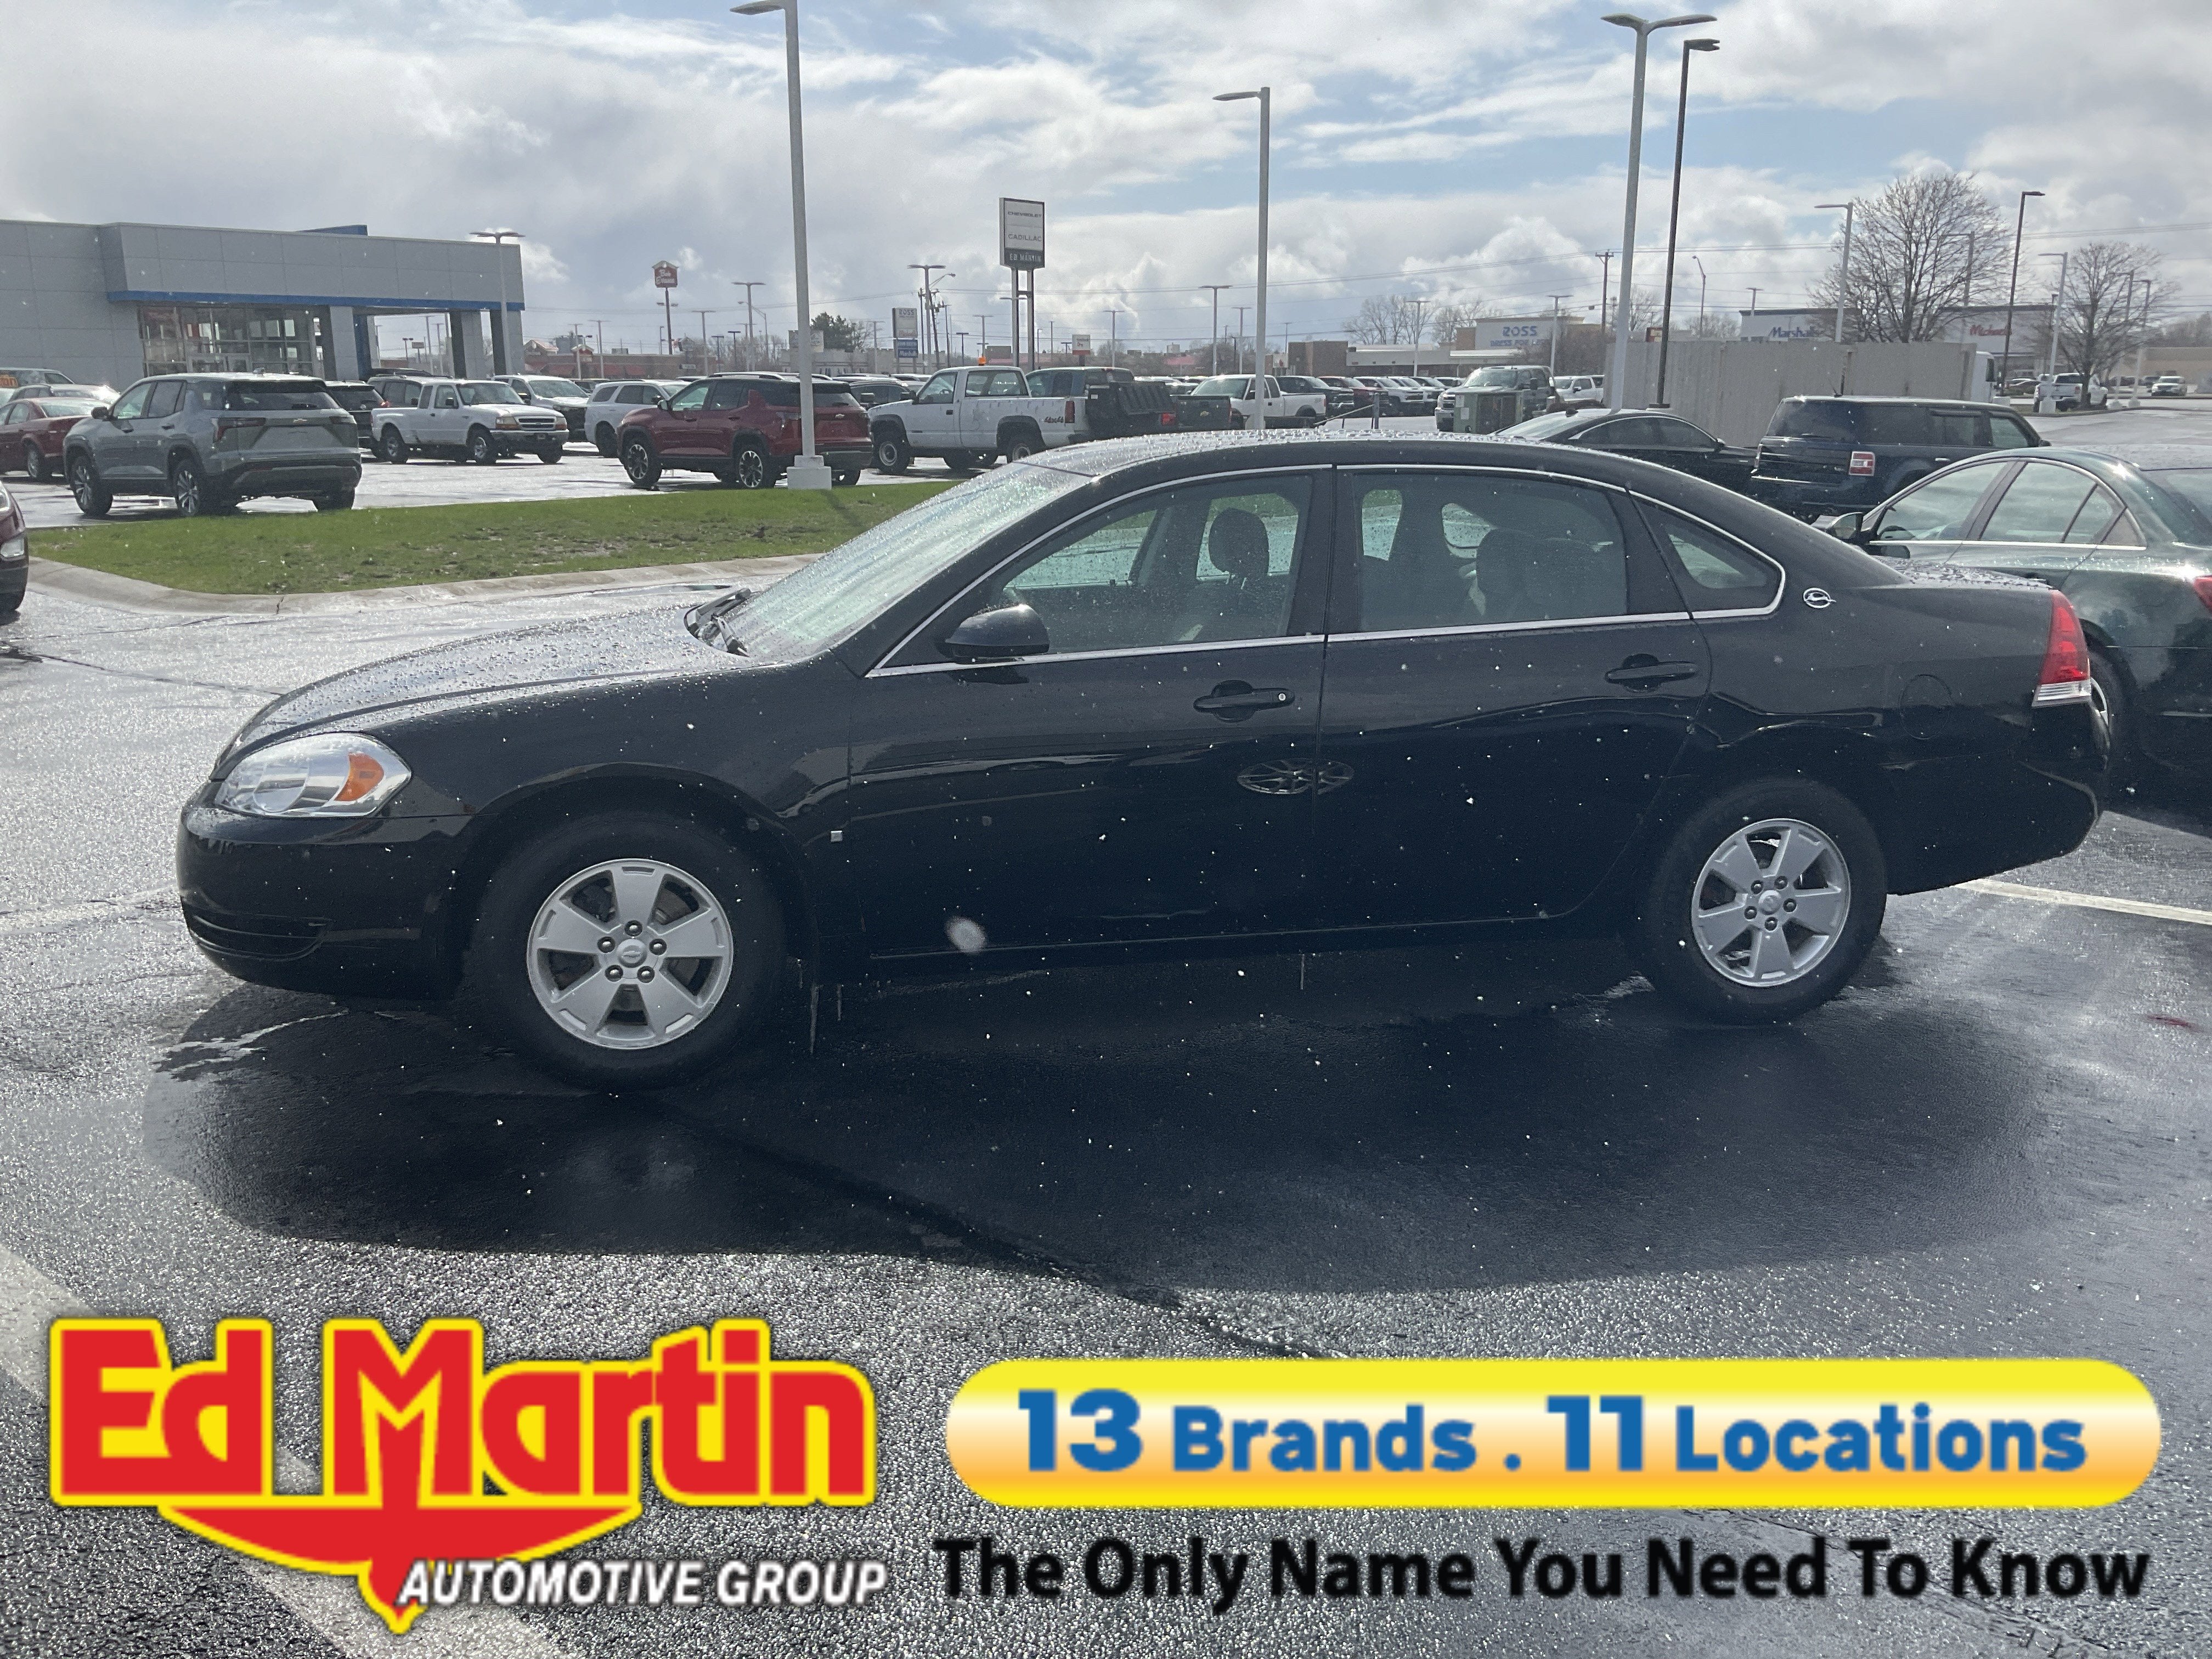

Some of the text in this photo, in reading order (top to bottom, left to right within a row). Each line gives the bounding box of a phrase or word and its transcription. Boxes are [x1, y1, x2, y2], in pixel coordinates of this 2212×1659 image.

[1008, 234, 1042, 242] CADILLAC
[1009, 252, 1042, 263] ED MARTIN
[1503, 326, 1537, 337] ROSS
